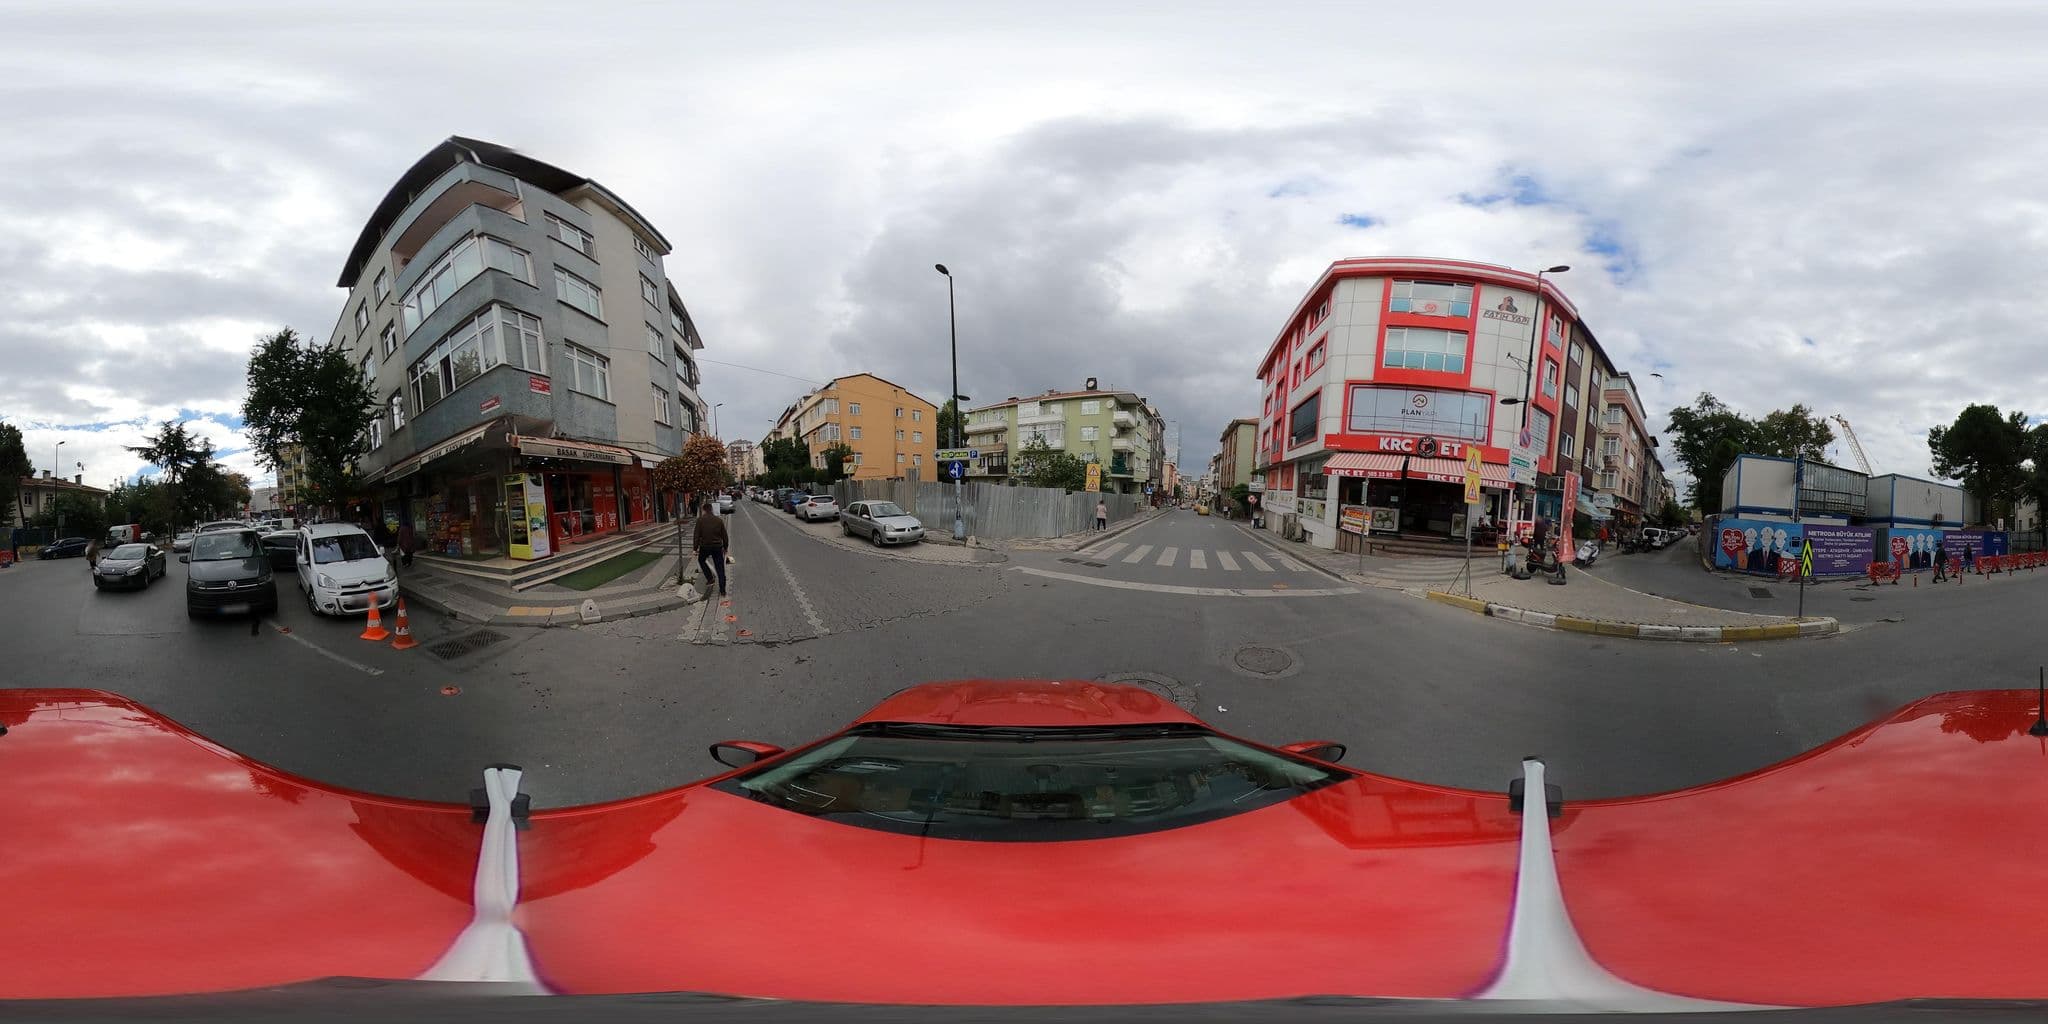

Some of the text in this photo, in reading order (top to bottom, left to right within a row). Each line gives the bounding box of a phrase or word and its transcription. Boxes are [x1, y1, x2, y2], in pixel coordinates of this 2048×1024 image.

[1379, 437, 1461, 457] KRC ET
[1331, 468, 1351, 476] KRC
[1427, 473, 1448, 482] KRC
